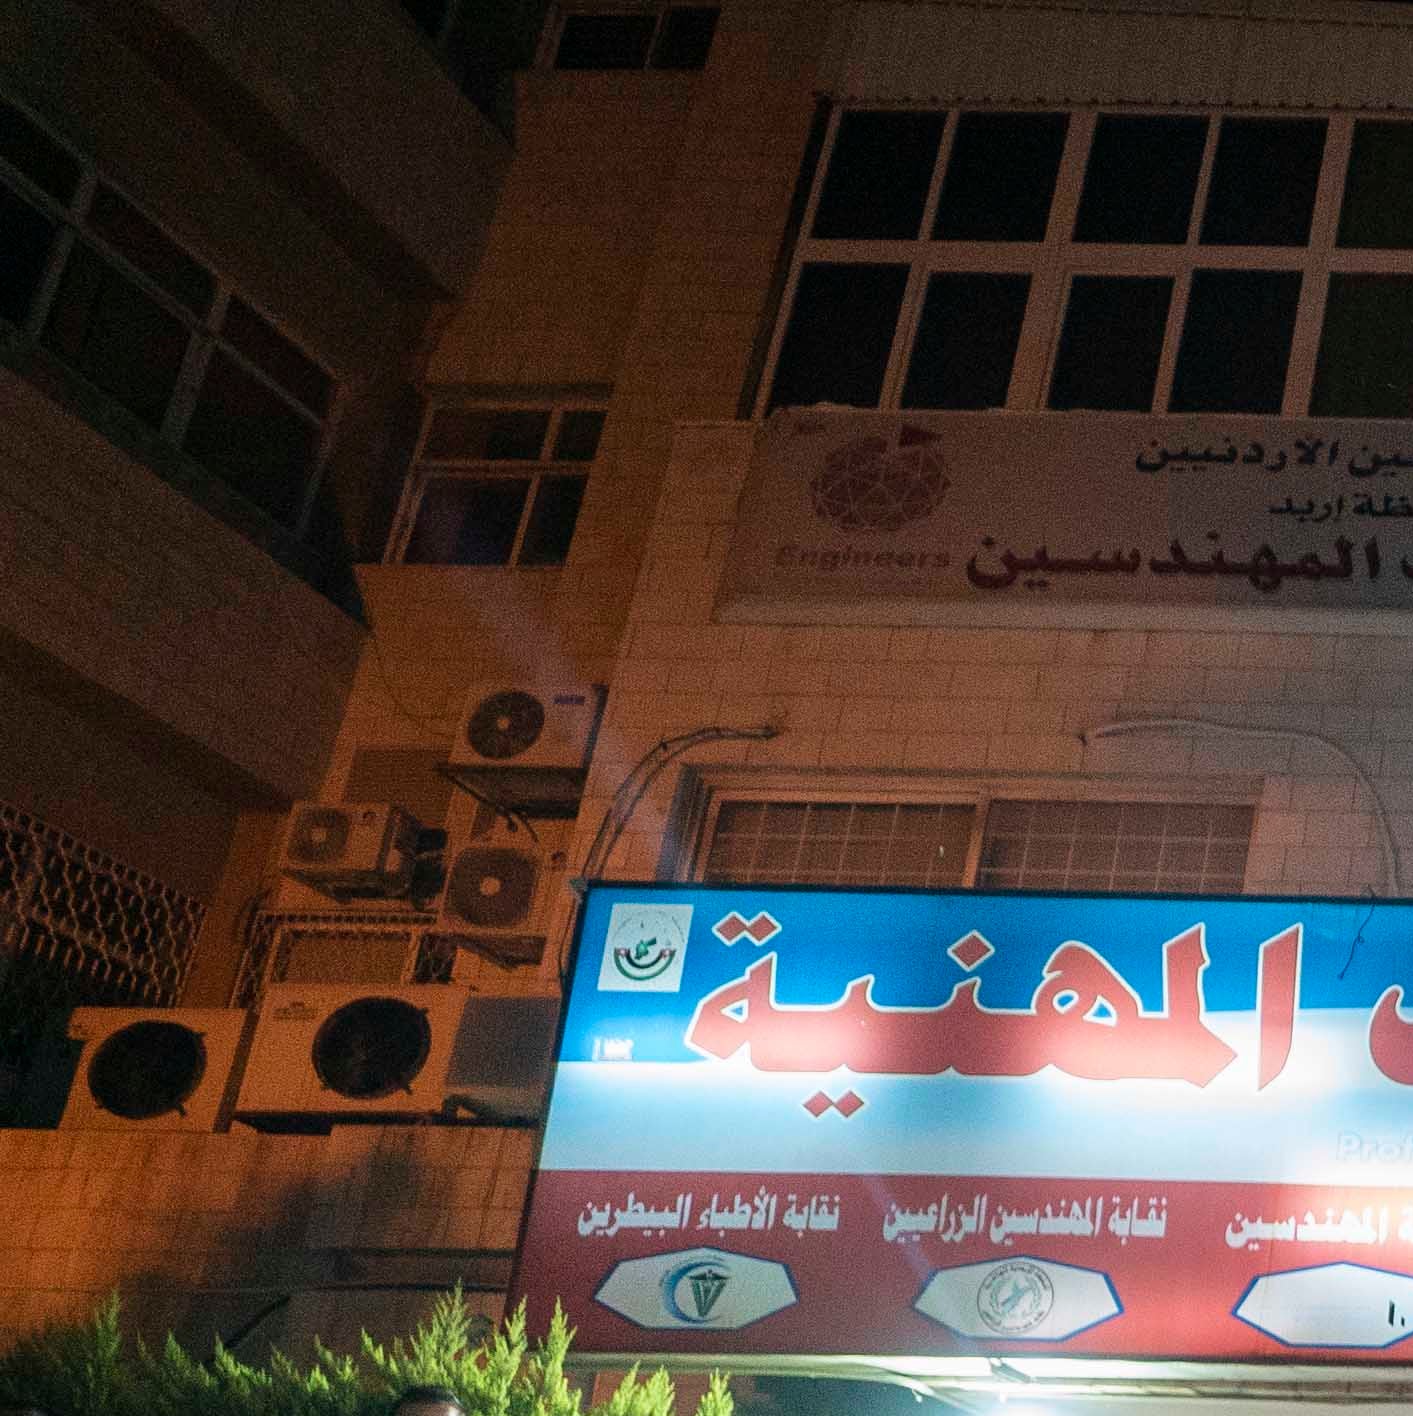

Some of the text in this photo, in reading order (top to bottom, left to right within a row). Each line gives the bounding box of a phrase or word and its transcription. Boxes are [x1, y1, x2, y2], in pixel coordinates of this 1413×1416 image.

[963, 528, 1386, 591] المهندسين
[684, 908, 1304, 1120] المهنية
[694, 1186, 776, 1238] الأطباء
[780, 1192, 838, 1235] نقابة
[989, 1194, 1102, 1246] المهندسين
[1107, 1194, 1167, 1246] نقابة
[1225, 1205, 1388, 1252] المهندسين
